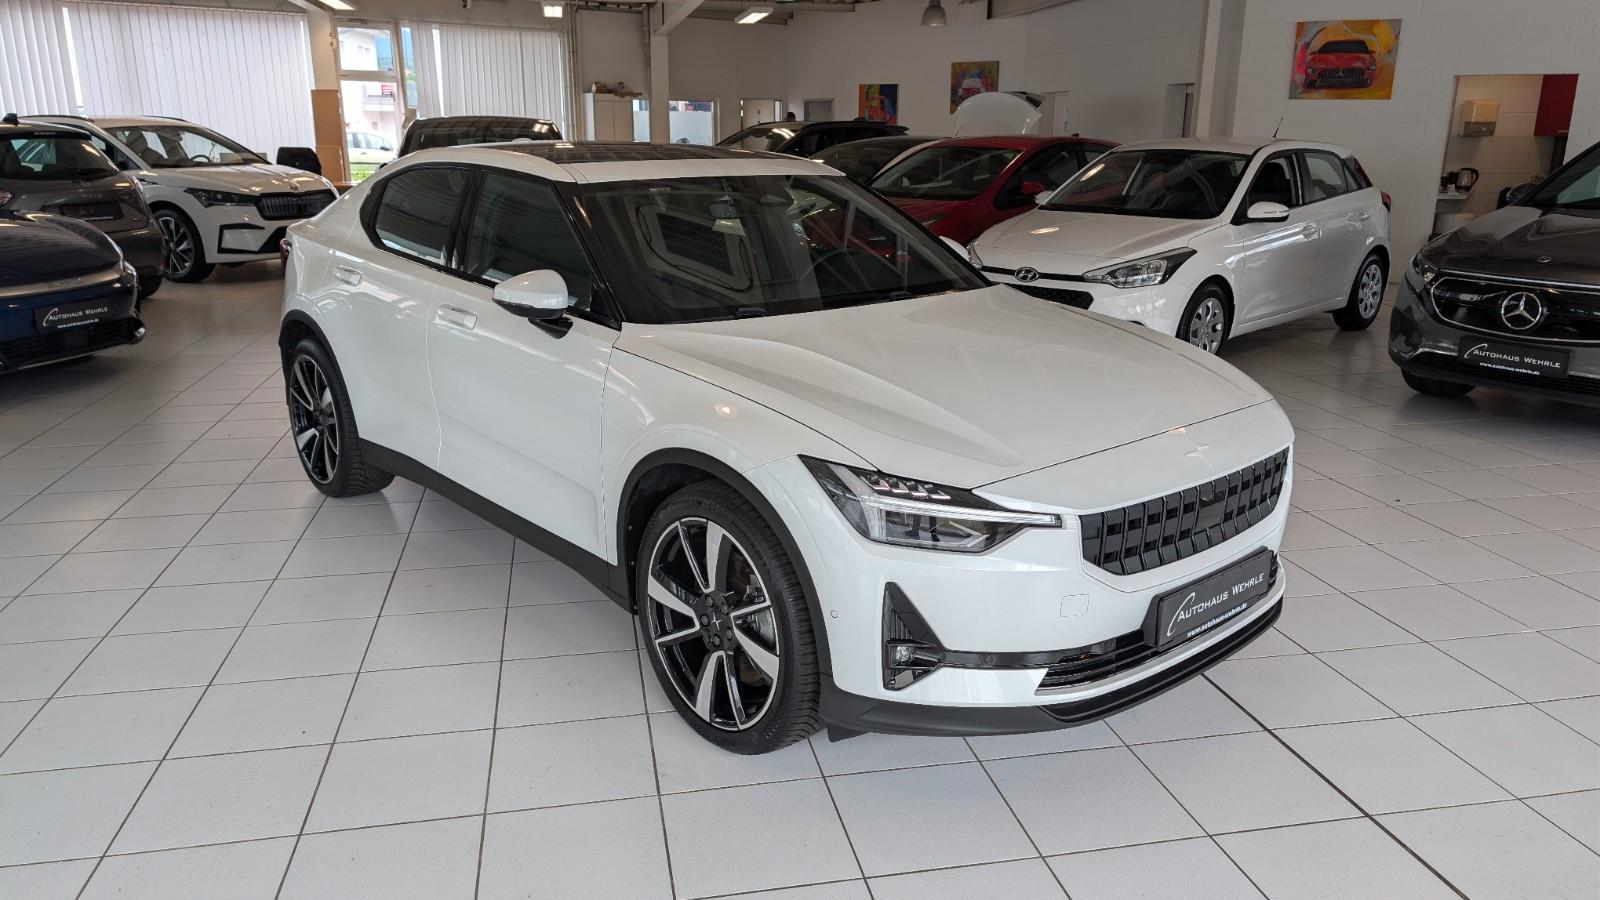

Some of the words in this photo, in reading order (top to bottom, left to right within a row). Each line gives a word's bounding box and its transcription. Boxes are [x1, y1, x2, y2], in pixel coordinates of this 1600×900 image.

[1473, 349, 1520, 362] AUTOHAUS
[1524, 356, 1561, 369] WEHRLE
[1177, 591, 1229, 622] AUTOHAUS
[1232, 573, 1264, 596] WEHRLE
